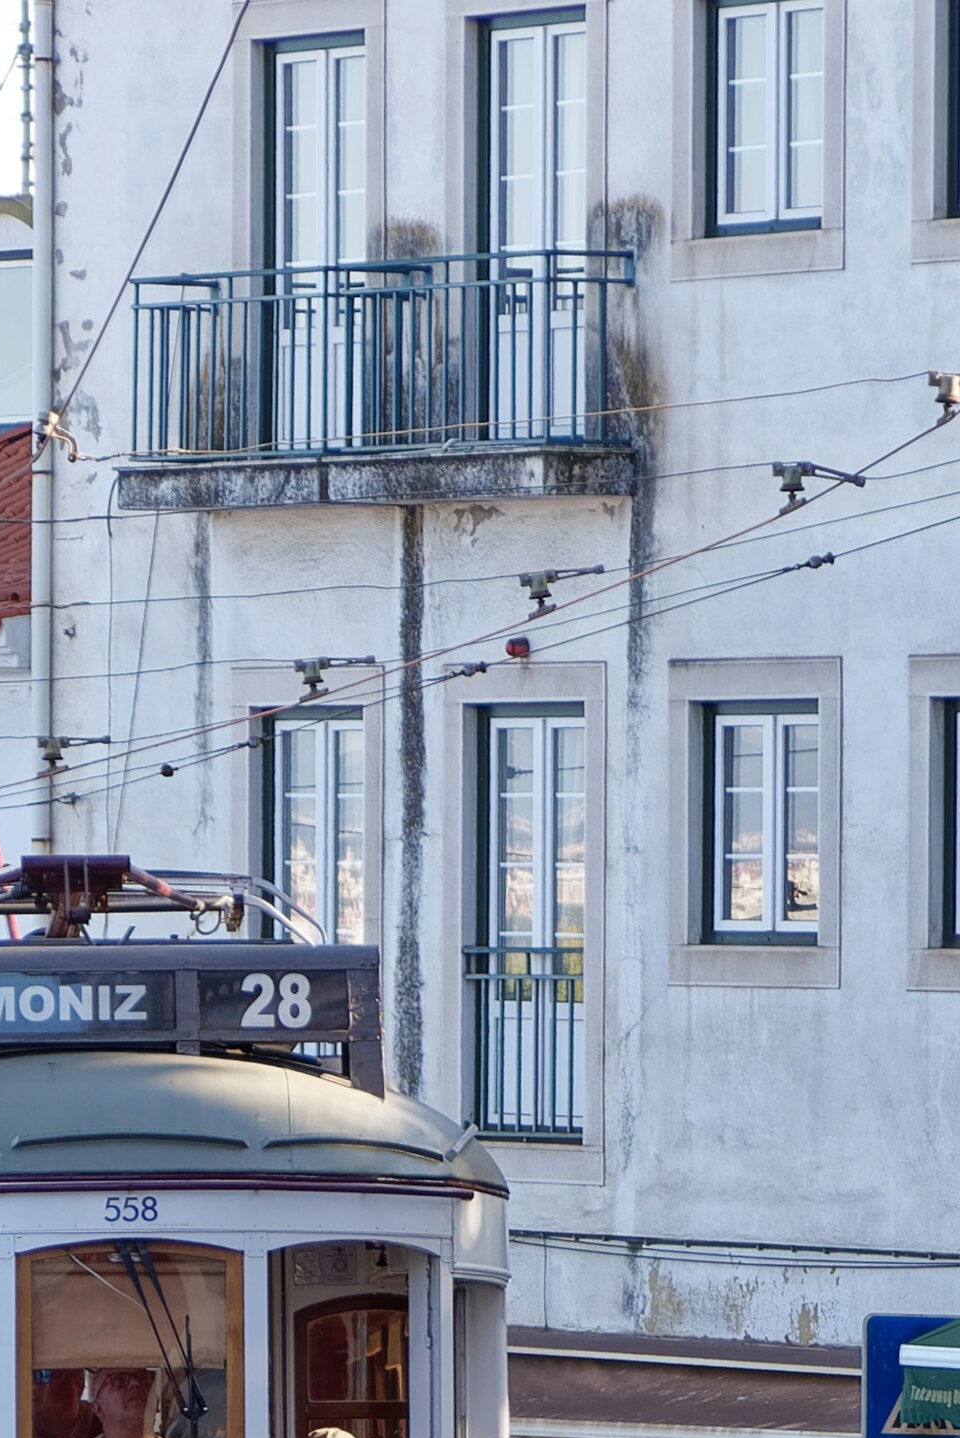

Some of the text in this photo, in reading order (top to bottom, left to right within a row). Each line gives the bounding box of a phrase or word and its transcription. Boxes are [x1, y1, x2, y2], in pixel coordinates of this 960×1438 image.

[241, 973, 312, 1029] 28
[104, 1196, 158, 1222] 558
[910, 1384, 952, 1408] Takeaway
